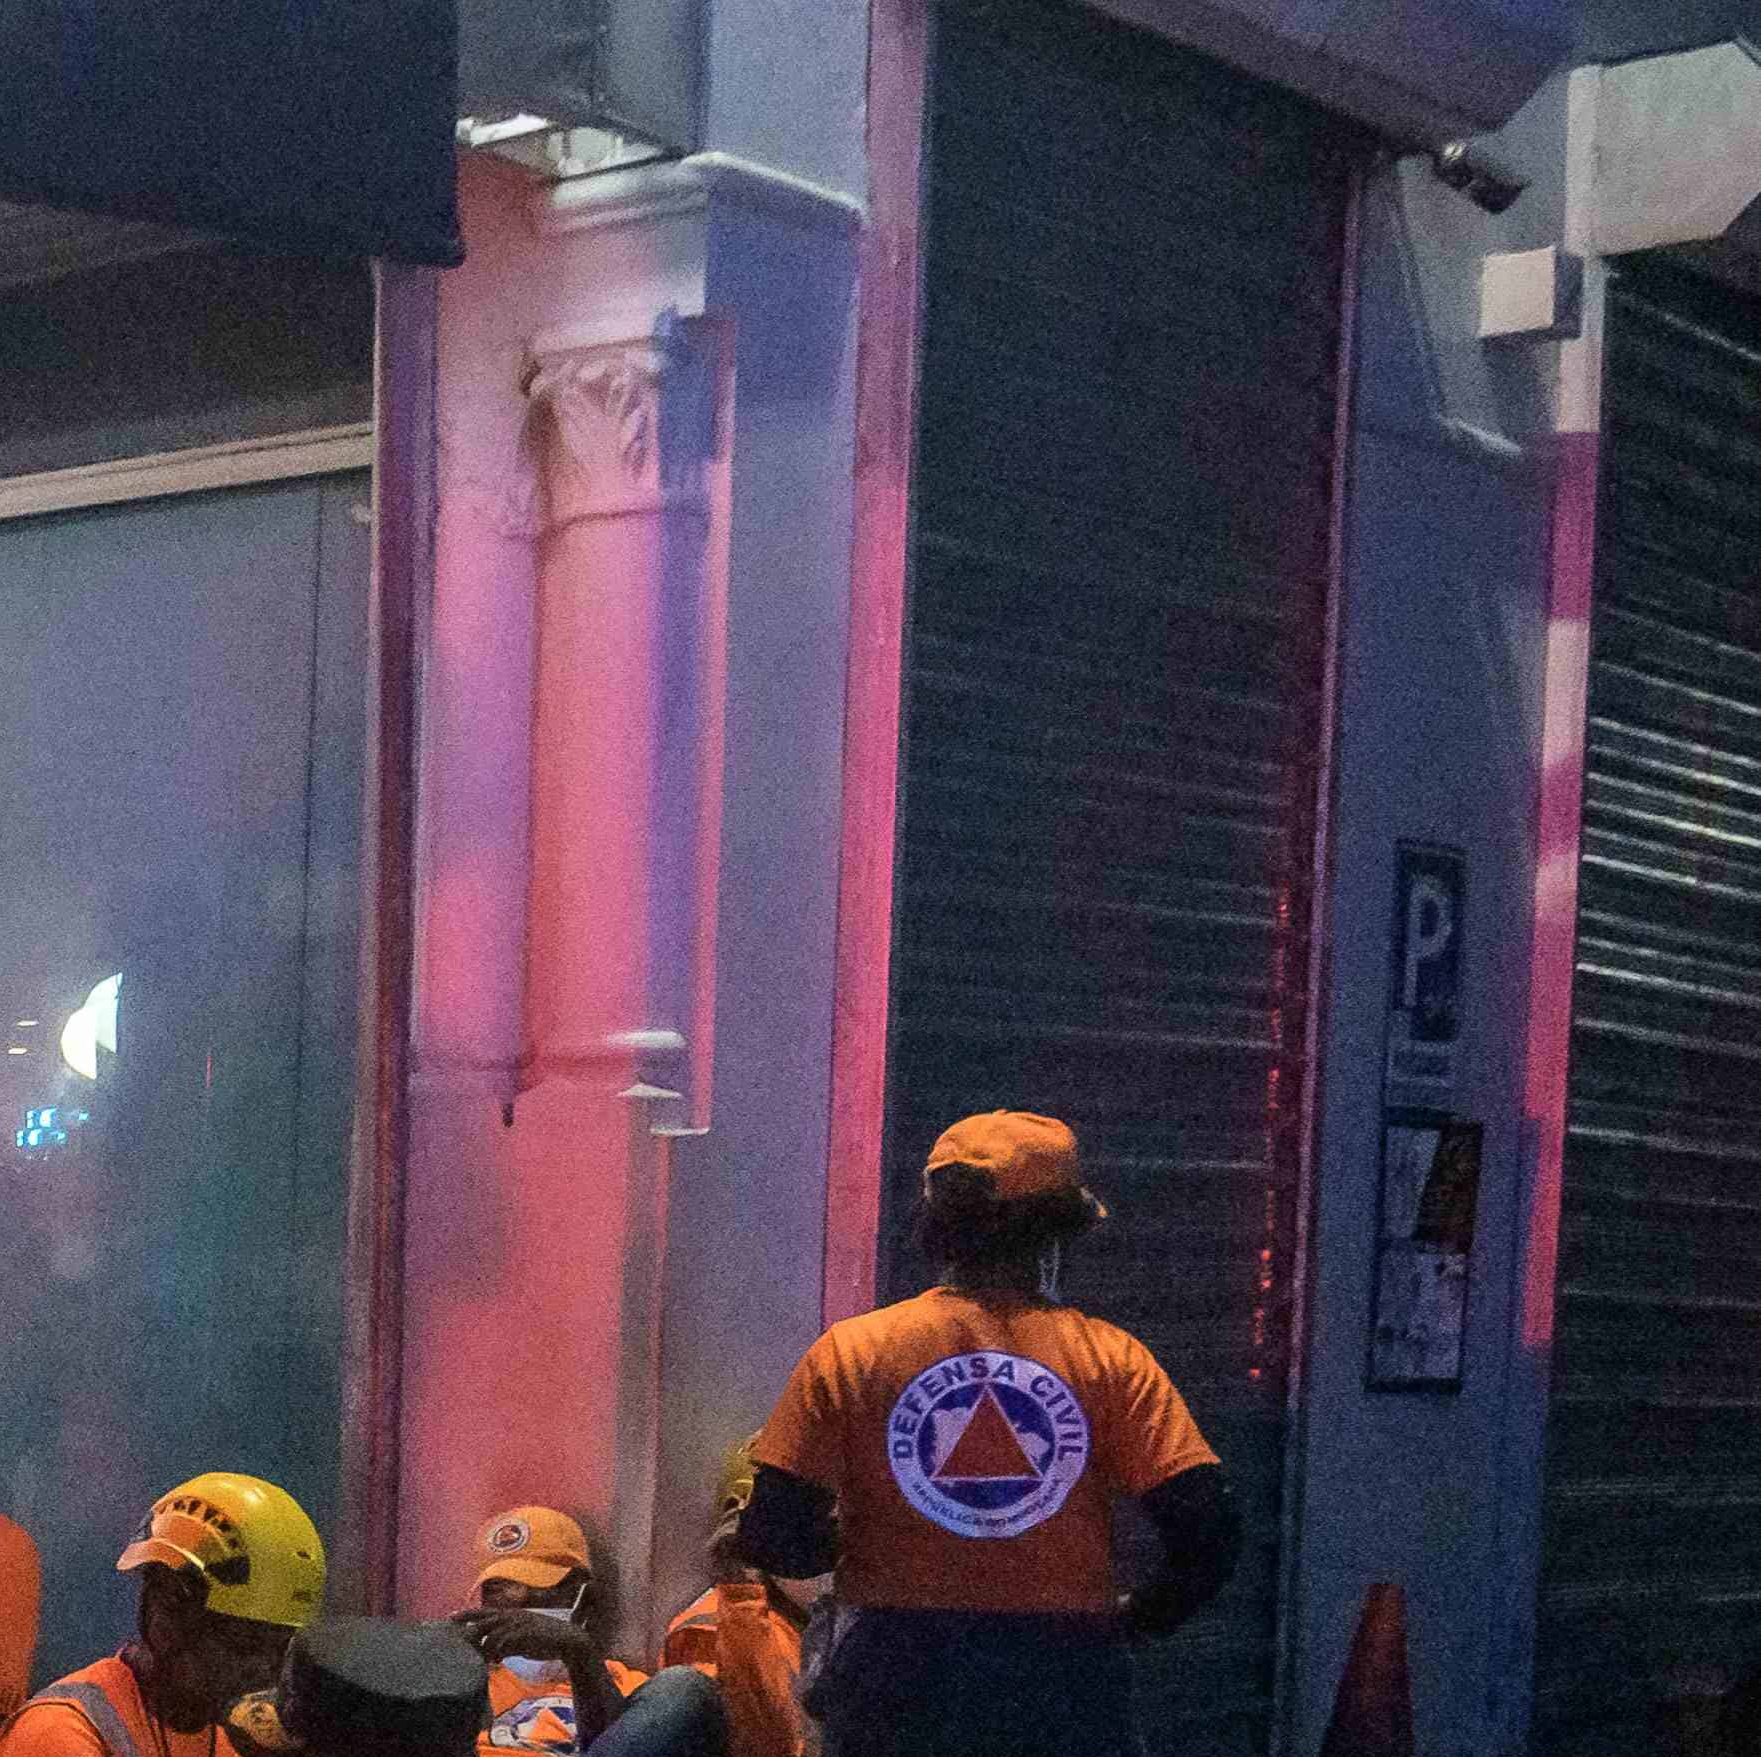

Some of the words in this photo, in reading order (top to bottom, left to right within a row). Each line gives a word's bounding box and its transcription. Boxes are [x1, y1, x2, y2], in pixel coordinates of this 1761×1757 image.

[1405, 875, 1453, 1007] P
[893, 1357, 1016, 1459] DEFENSA
[1030, 1375, 1083, 1461] CIVIL
